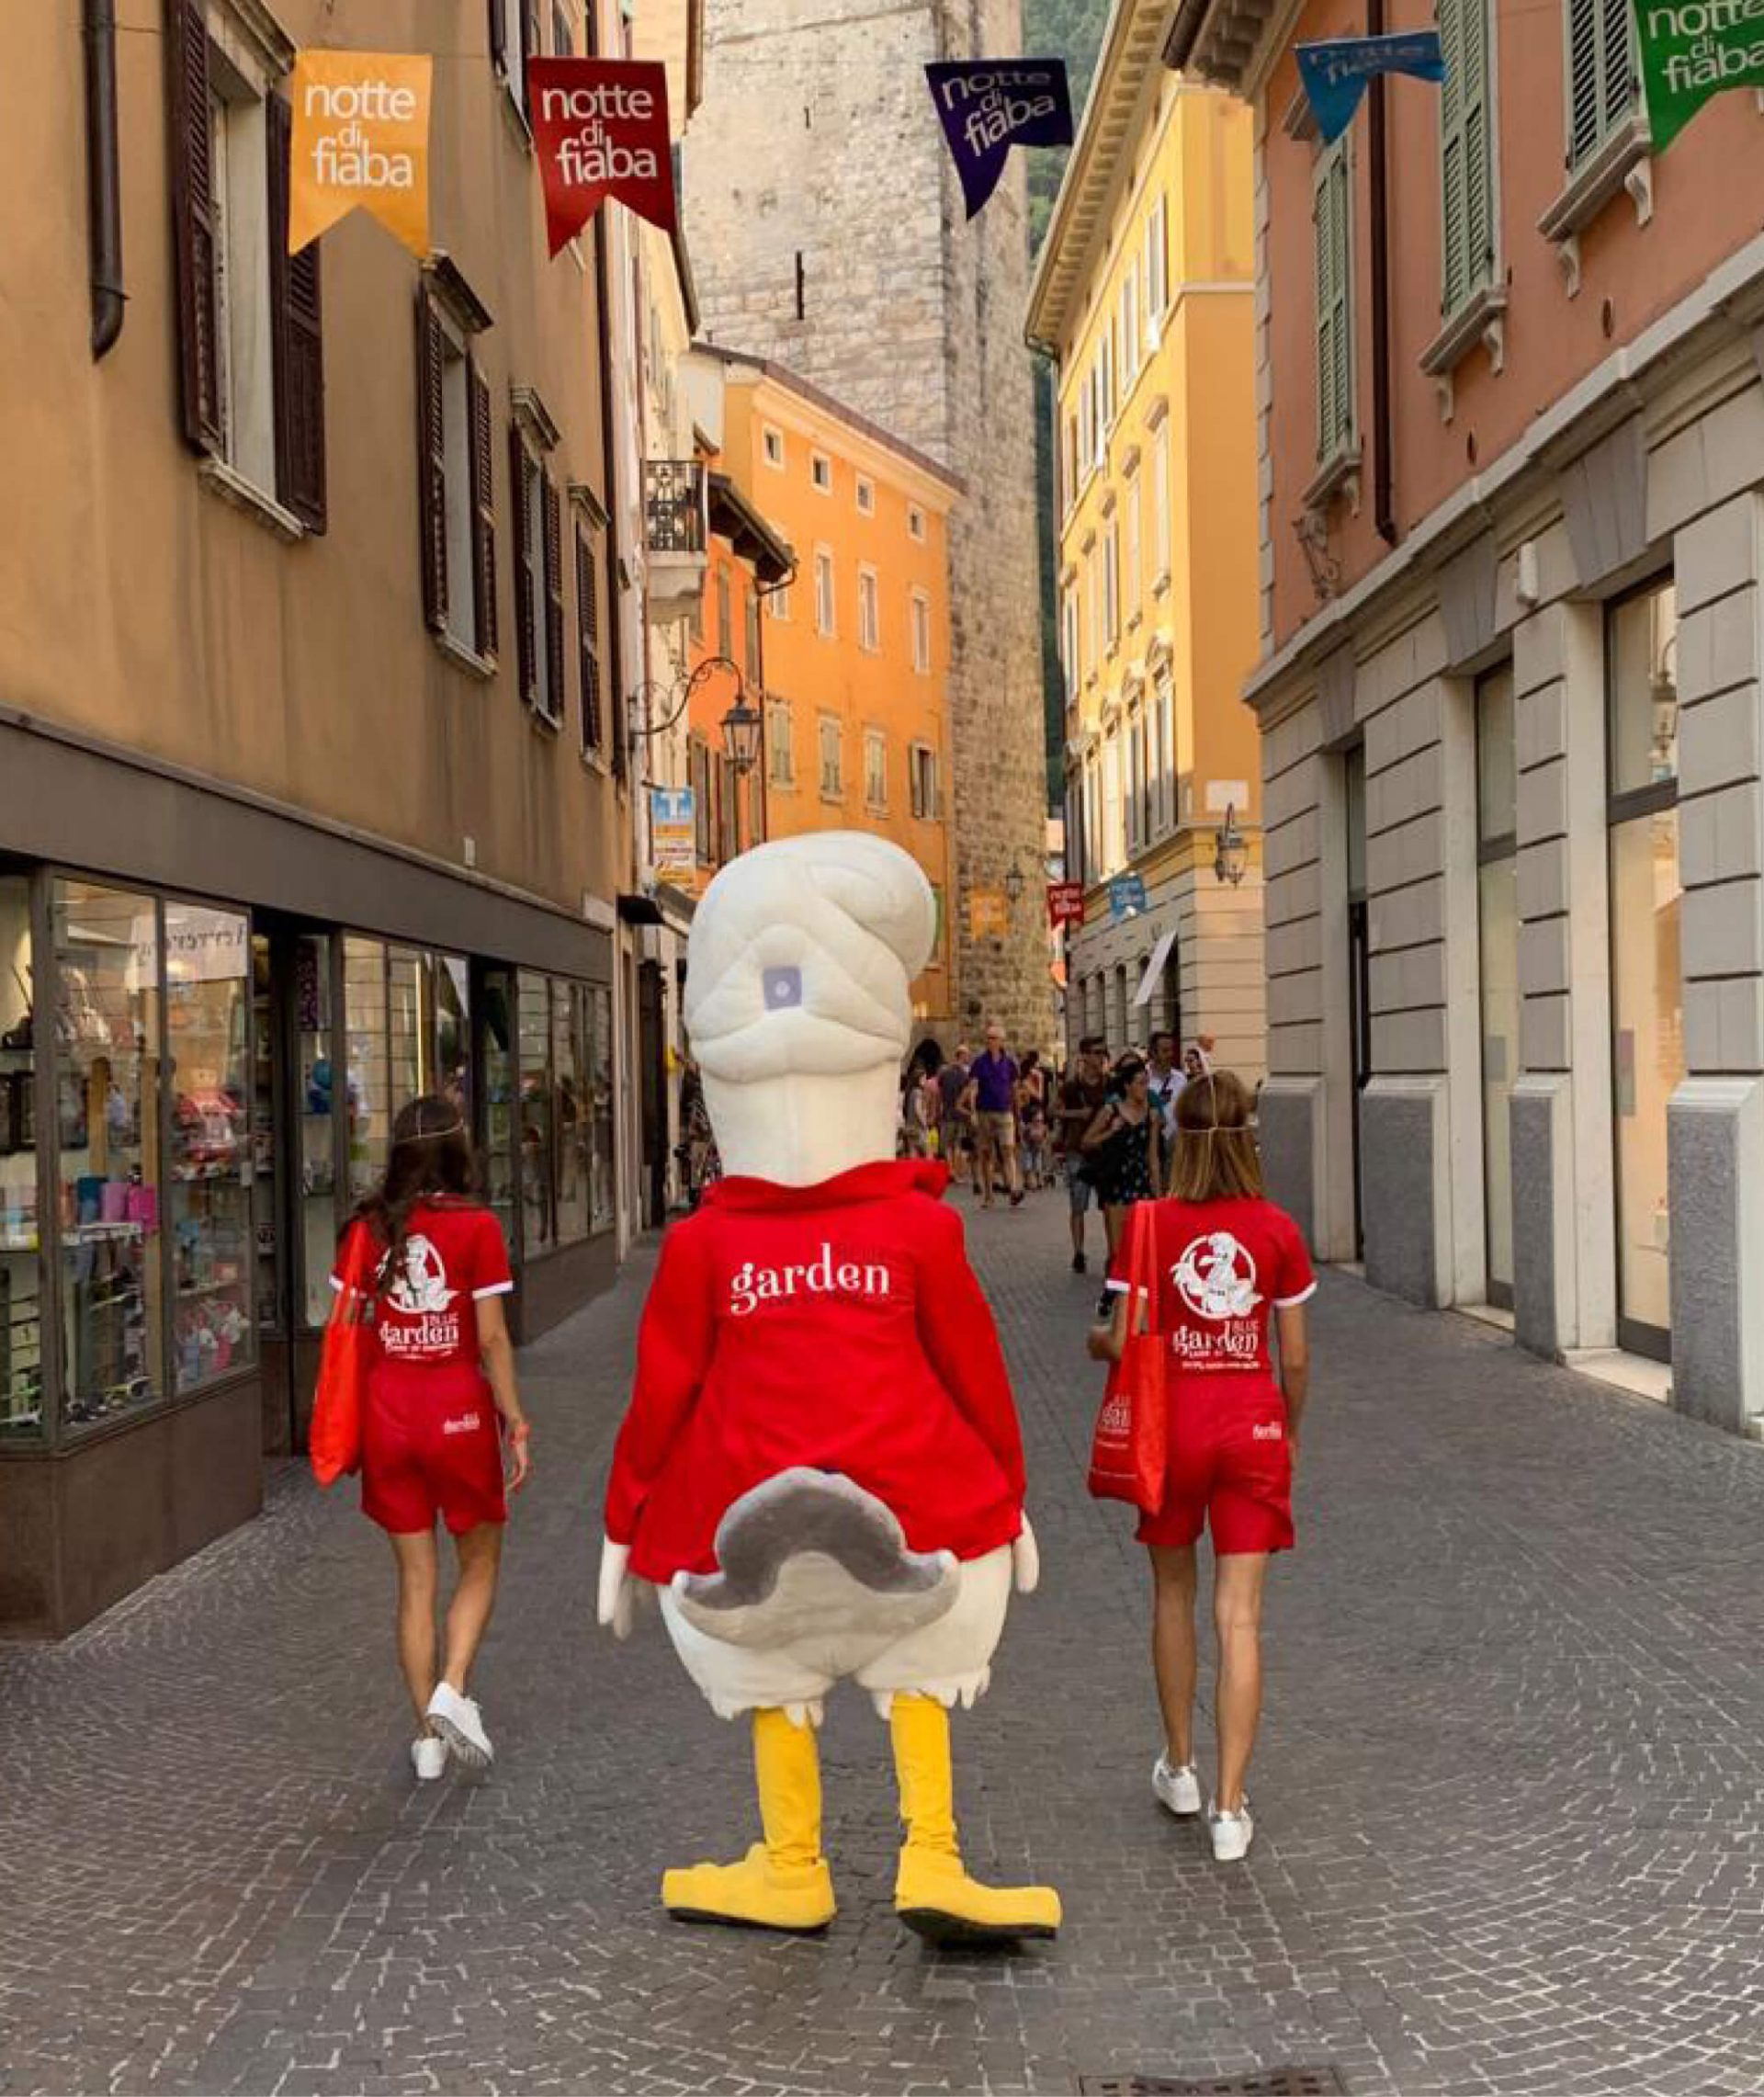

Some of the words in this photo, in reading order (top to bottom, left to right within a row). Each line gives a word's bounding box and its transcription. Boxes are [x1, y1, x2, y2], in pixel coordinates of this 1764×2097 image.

[1648, 0, 1764, 39] notte
[1690, 34, 1714, 58] di
[304, 80, 416, 122] notte
[542, 85, 654, 121] notte
[942, 71, 1052, 111] notte
[980, 89, 1002, 111] di
[337, 121, 362, 148] di
[580, 119, 604, 148] di
[965, 95, 1056, 157] fiaba
[311, 137, 413, 187] fiaba
[555, 137, 658, 185] fiaba
[730, 1242, 890, 1316] garden
